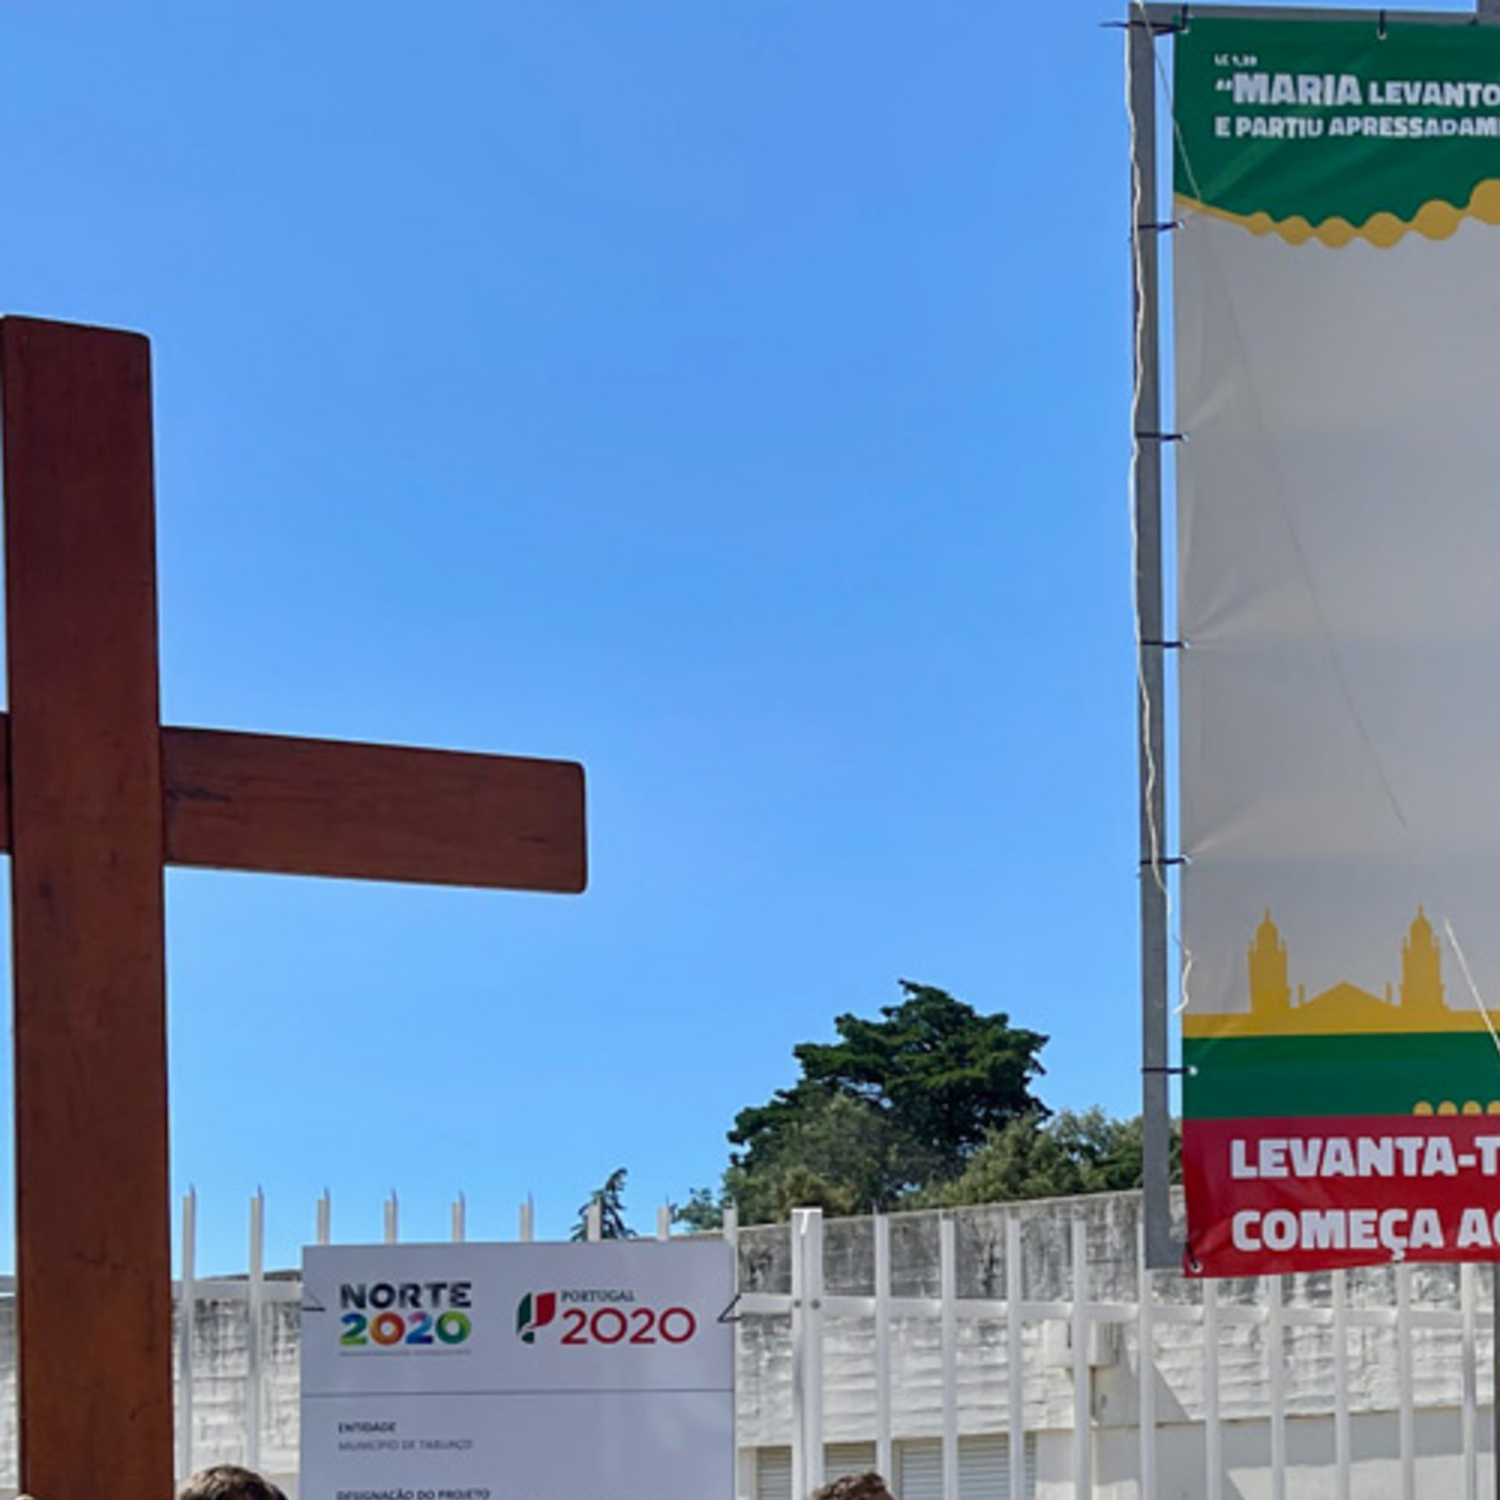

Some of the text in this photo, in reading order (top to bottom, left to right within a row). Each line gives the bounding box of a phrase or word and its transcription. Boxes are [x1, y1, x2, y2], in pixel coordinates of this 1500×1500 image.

[1215, 72, 1363, 106] “MARIA
[1214, 115, 1231, 138] E
[1235, 116, 1324, 139] PARTIU
[1231, 1207, 1445, 1262] COMEÇA
[340, 1281, 473, 1310] NORTE
[560, 1290, 637, 1303] PORTUGAL
[339, 1310, 472, 1347] 2020
[560, 1306, 697, 1345] 2020
[337, 1421, 397, 1434] ENTIDADE
[416, 1489, 436, 1500] DO
[437, 1488, 491, 1500] PROJETO
